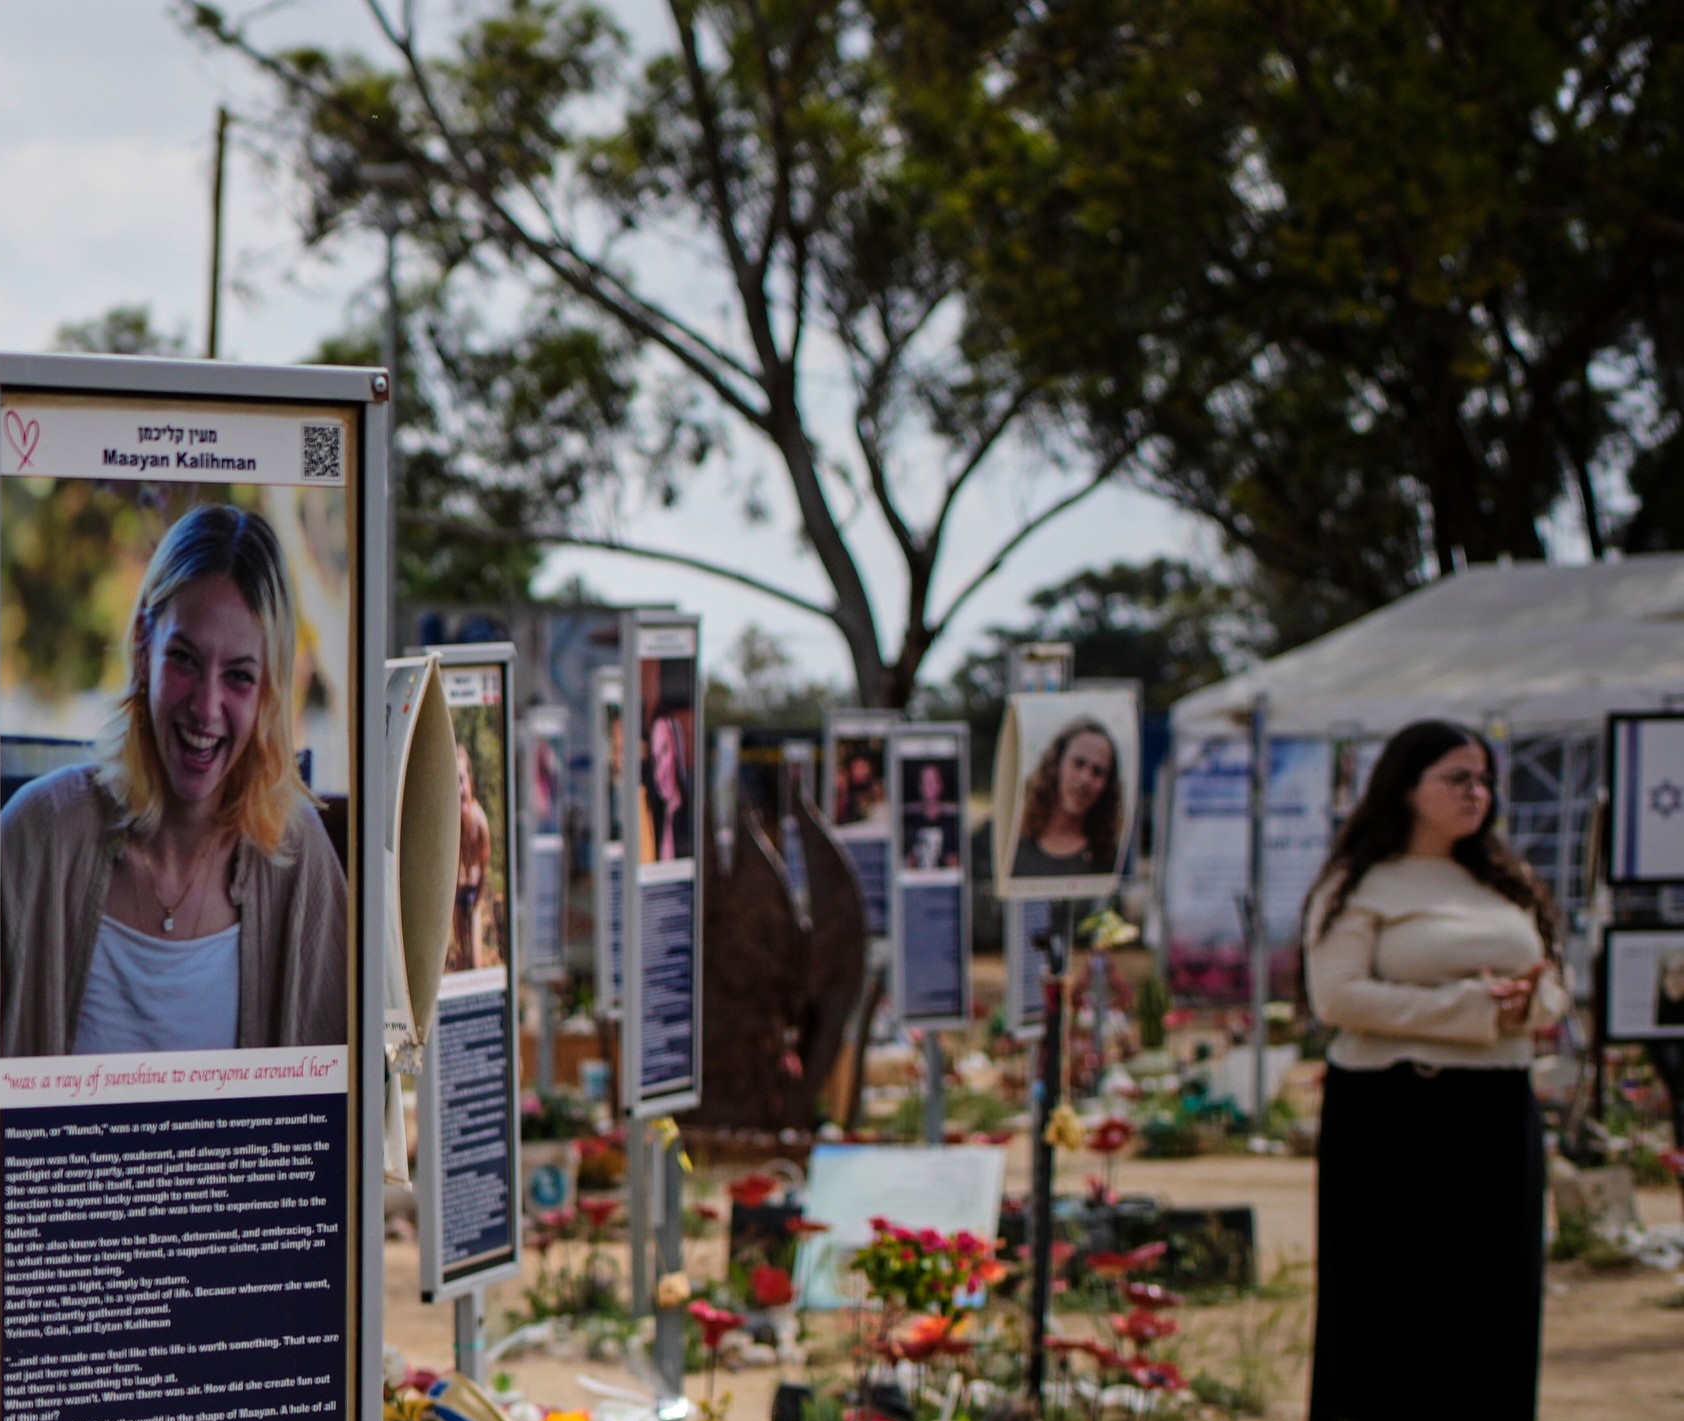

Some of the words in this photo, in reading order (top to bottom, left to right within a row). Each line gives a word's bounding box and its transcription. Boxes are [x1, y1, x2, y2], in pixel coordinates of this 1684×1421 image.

[138, 424, 185, 444] קליכמן
[188, 428, 218, 445] מעין
[103, 449, 170, 471] Maayan
[176, 452, 257, 471] Kalihman
[41, 1076, 50, 1089] a
[56, 1075, 81, 1097] ray
[85, 1064, 105, 1096] of
[104, 1062, 168, 1088] sunshine
[172, 1069, 185, 1083] to
[189, 1068, 250, 1090] everyone
[254, 1057, 306, 1080] around
[48, 1127, 61, 1136] or
[108, 1124, 131, 1133] was
[131, 1123, 139, 1132] a
[140, 1123, 158, 1134] ray
[158, 1120, 170, 1131] of
[171, 1119, 215, 1131] sunshine
[216, 1118, 228, 1128] to
[228, 1117, 273, 1129] everyone
[274, 1113, 308, 1125] around
[4, 1156, 45, 1168] Maayan
[45, 1156, 68, 1165] was
[176, 1147, 196, 1158] and
[196, 1146, 231, 1158] always
[271, 1142, 291, 1153] She
[291, 1143, 312, 1152] was
[313, 1140, 330, 1151] the
[3, 1385, 26, 1396] that
[26, 1383, 55, 1394] there
[56, 1382, 67, 1391] is
[68, 1378, 121, 1391] something
[121, 1377, 134, 1386] to
[134, 1373, 163, 1387] laugh
[3, 1399, 34, 1410] When
[34, 1397, 63, 1408] there
[101, 1391, 135, 1402] Where
[135, 1389, 163, 1399] there
[164, 1387, 185, 1397] was
[203, 1383, 226, 1394] How
[227, 1380, 243, 1392] did
[244, 1380, 263, 1390] she
[263, 1377, 295, 1389] create
[296, 1375, 313, 1386] fun
[313, 1374, 330, 1384] out
[39, 1409, 60, 1421] air?
